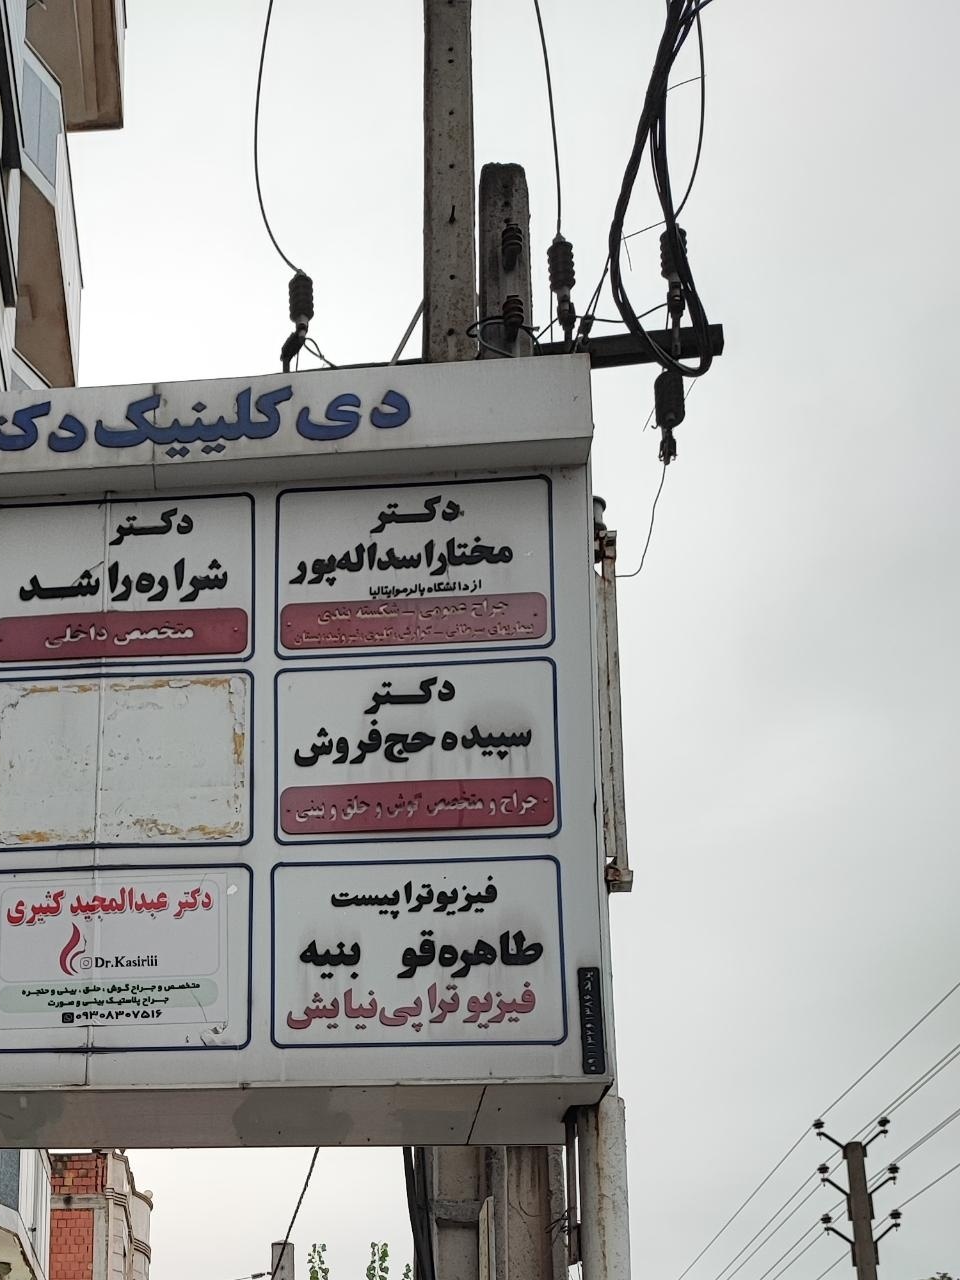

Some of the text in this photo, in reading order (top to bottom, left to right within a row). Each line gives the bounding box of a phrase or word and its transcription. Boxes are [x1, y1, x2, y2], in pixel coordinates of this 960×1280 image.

[94, 385, 294, 458] کلینیک
[296, 389, 411, 442] دی
[109, 507, 193, 545] دکتر
[370, 495, 461, 534] دکتر
[430, 536, 513, 576] مختار
[19, 558, 228, 602] شراره راشد
[356, 603, 400, 620] شکسته
[419, 603, 467, 620] عمومی
[472, 598, 508, 615] جراح
[45, 622, 194, 648] متخصص داخلی
[364, 676, 455, 714] دکتر
[441, 725, 532, 760] سپیده
[295, 789, 538, 823] جراح و متخصص گوش و حلق و بینی
[6, 886, 213, 926] دکتر عبدالمجید کثیری
[331, 875, 498, 919] فیزیوتراپیست
[299, 929, 544, 979] طاهره قو بنیه
[22, 988, 50, 998] حنجره
[48, 998, 74, 1009] صورت
[83, 998, 105, 1007] بینی
[106, 995, 141, 1006] پلاستیک
[131, 983, 157, 994] جراح
[142, 995, 169, 1006] جراح
[165, 982, 201, 992] متخصص
[287, 981, 536, 1032] فیزیوتراپی نیایش
